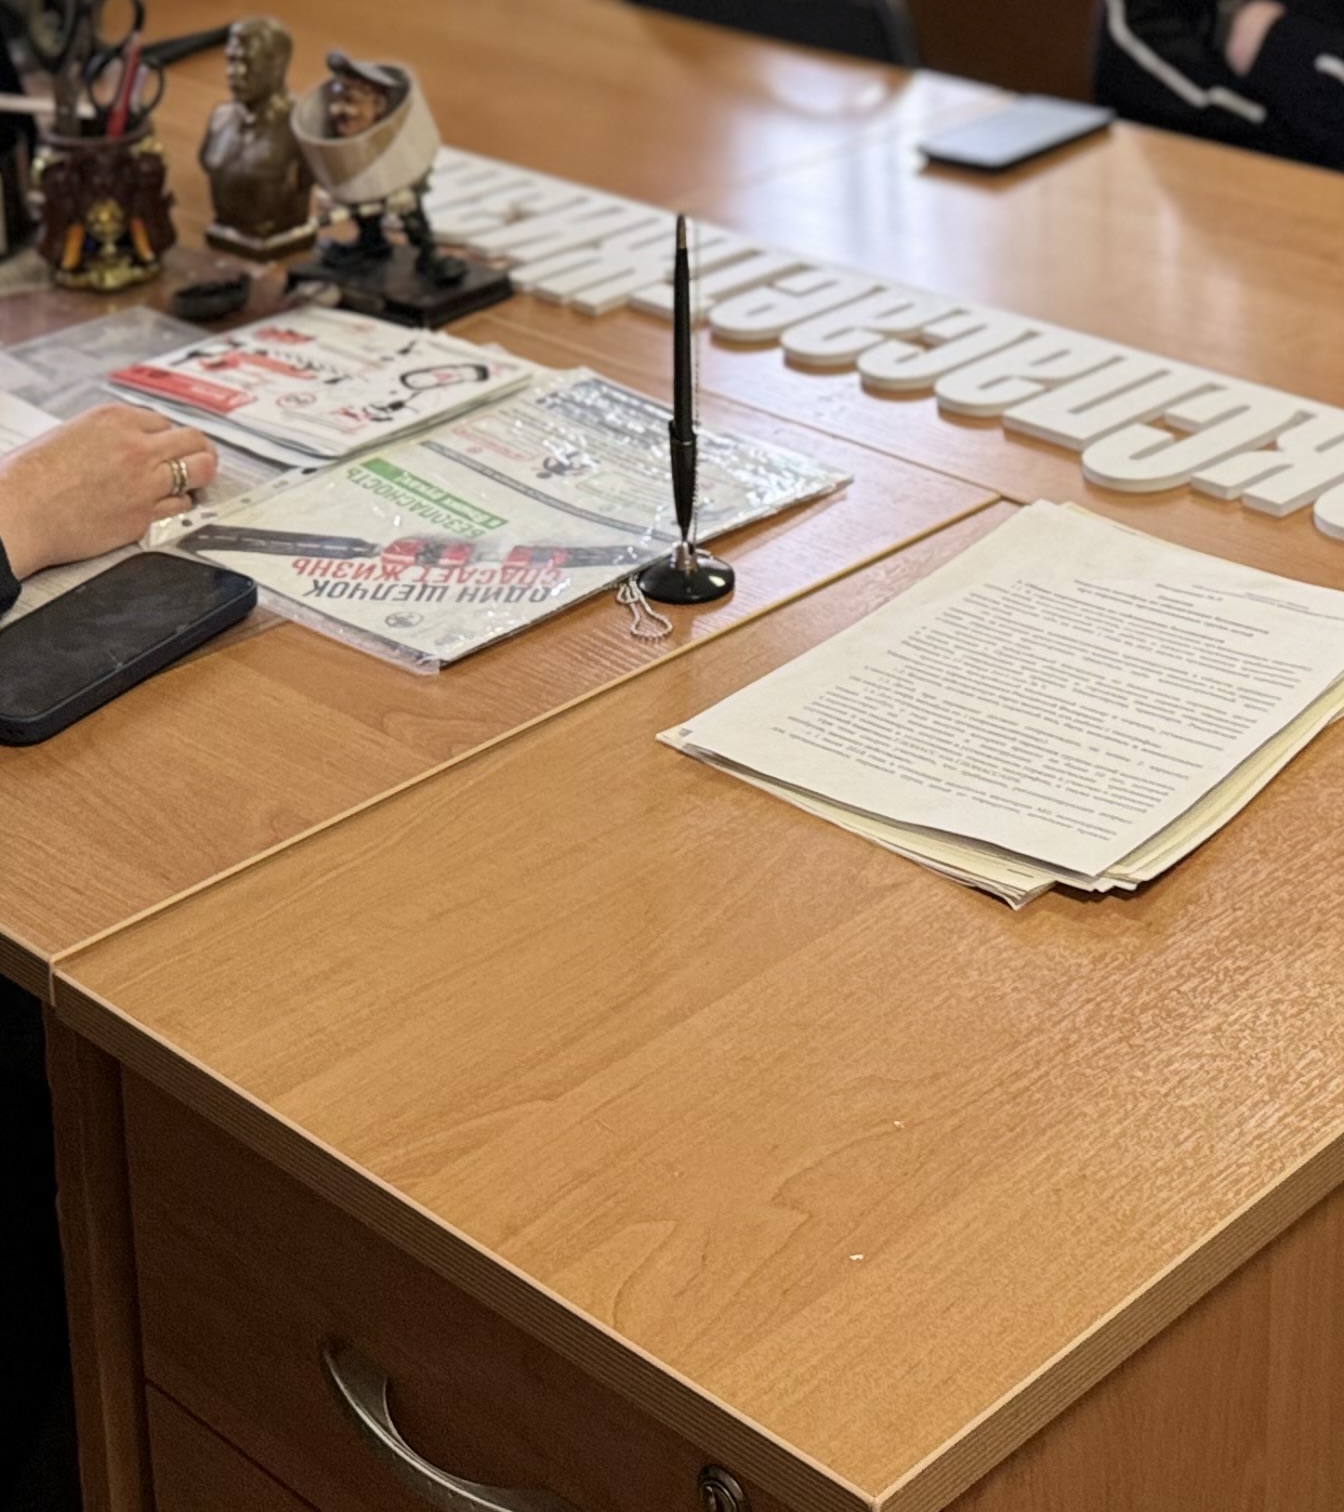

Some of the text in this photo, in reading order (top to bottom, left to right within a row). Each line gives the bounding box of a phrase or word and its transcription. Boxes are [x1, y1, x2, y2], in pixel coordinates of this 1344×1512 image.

[347, 467, 486, 539] БЕЗОПАСНОСТЬ
[291, 557, 562, 587] СПАСАЕТ ЖИЗНЬ
[301, 578, 552, 604] ОДИН ЩЕЛЧОК
